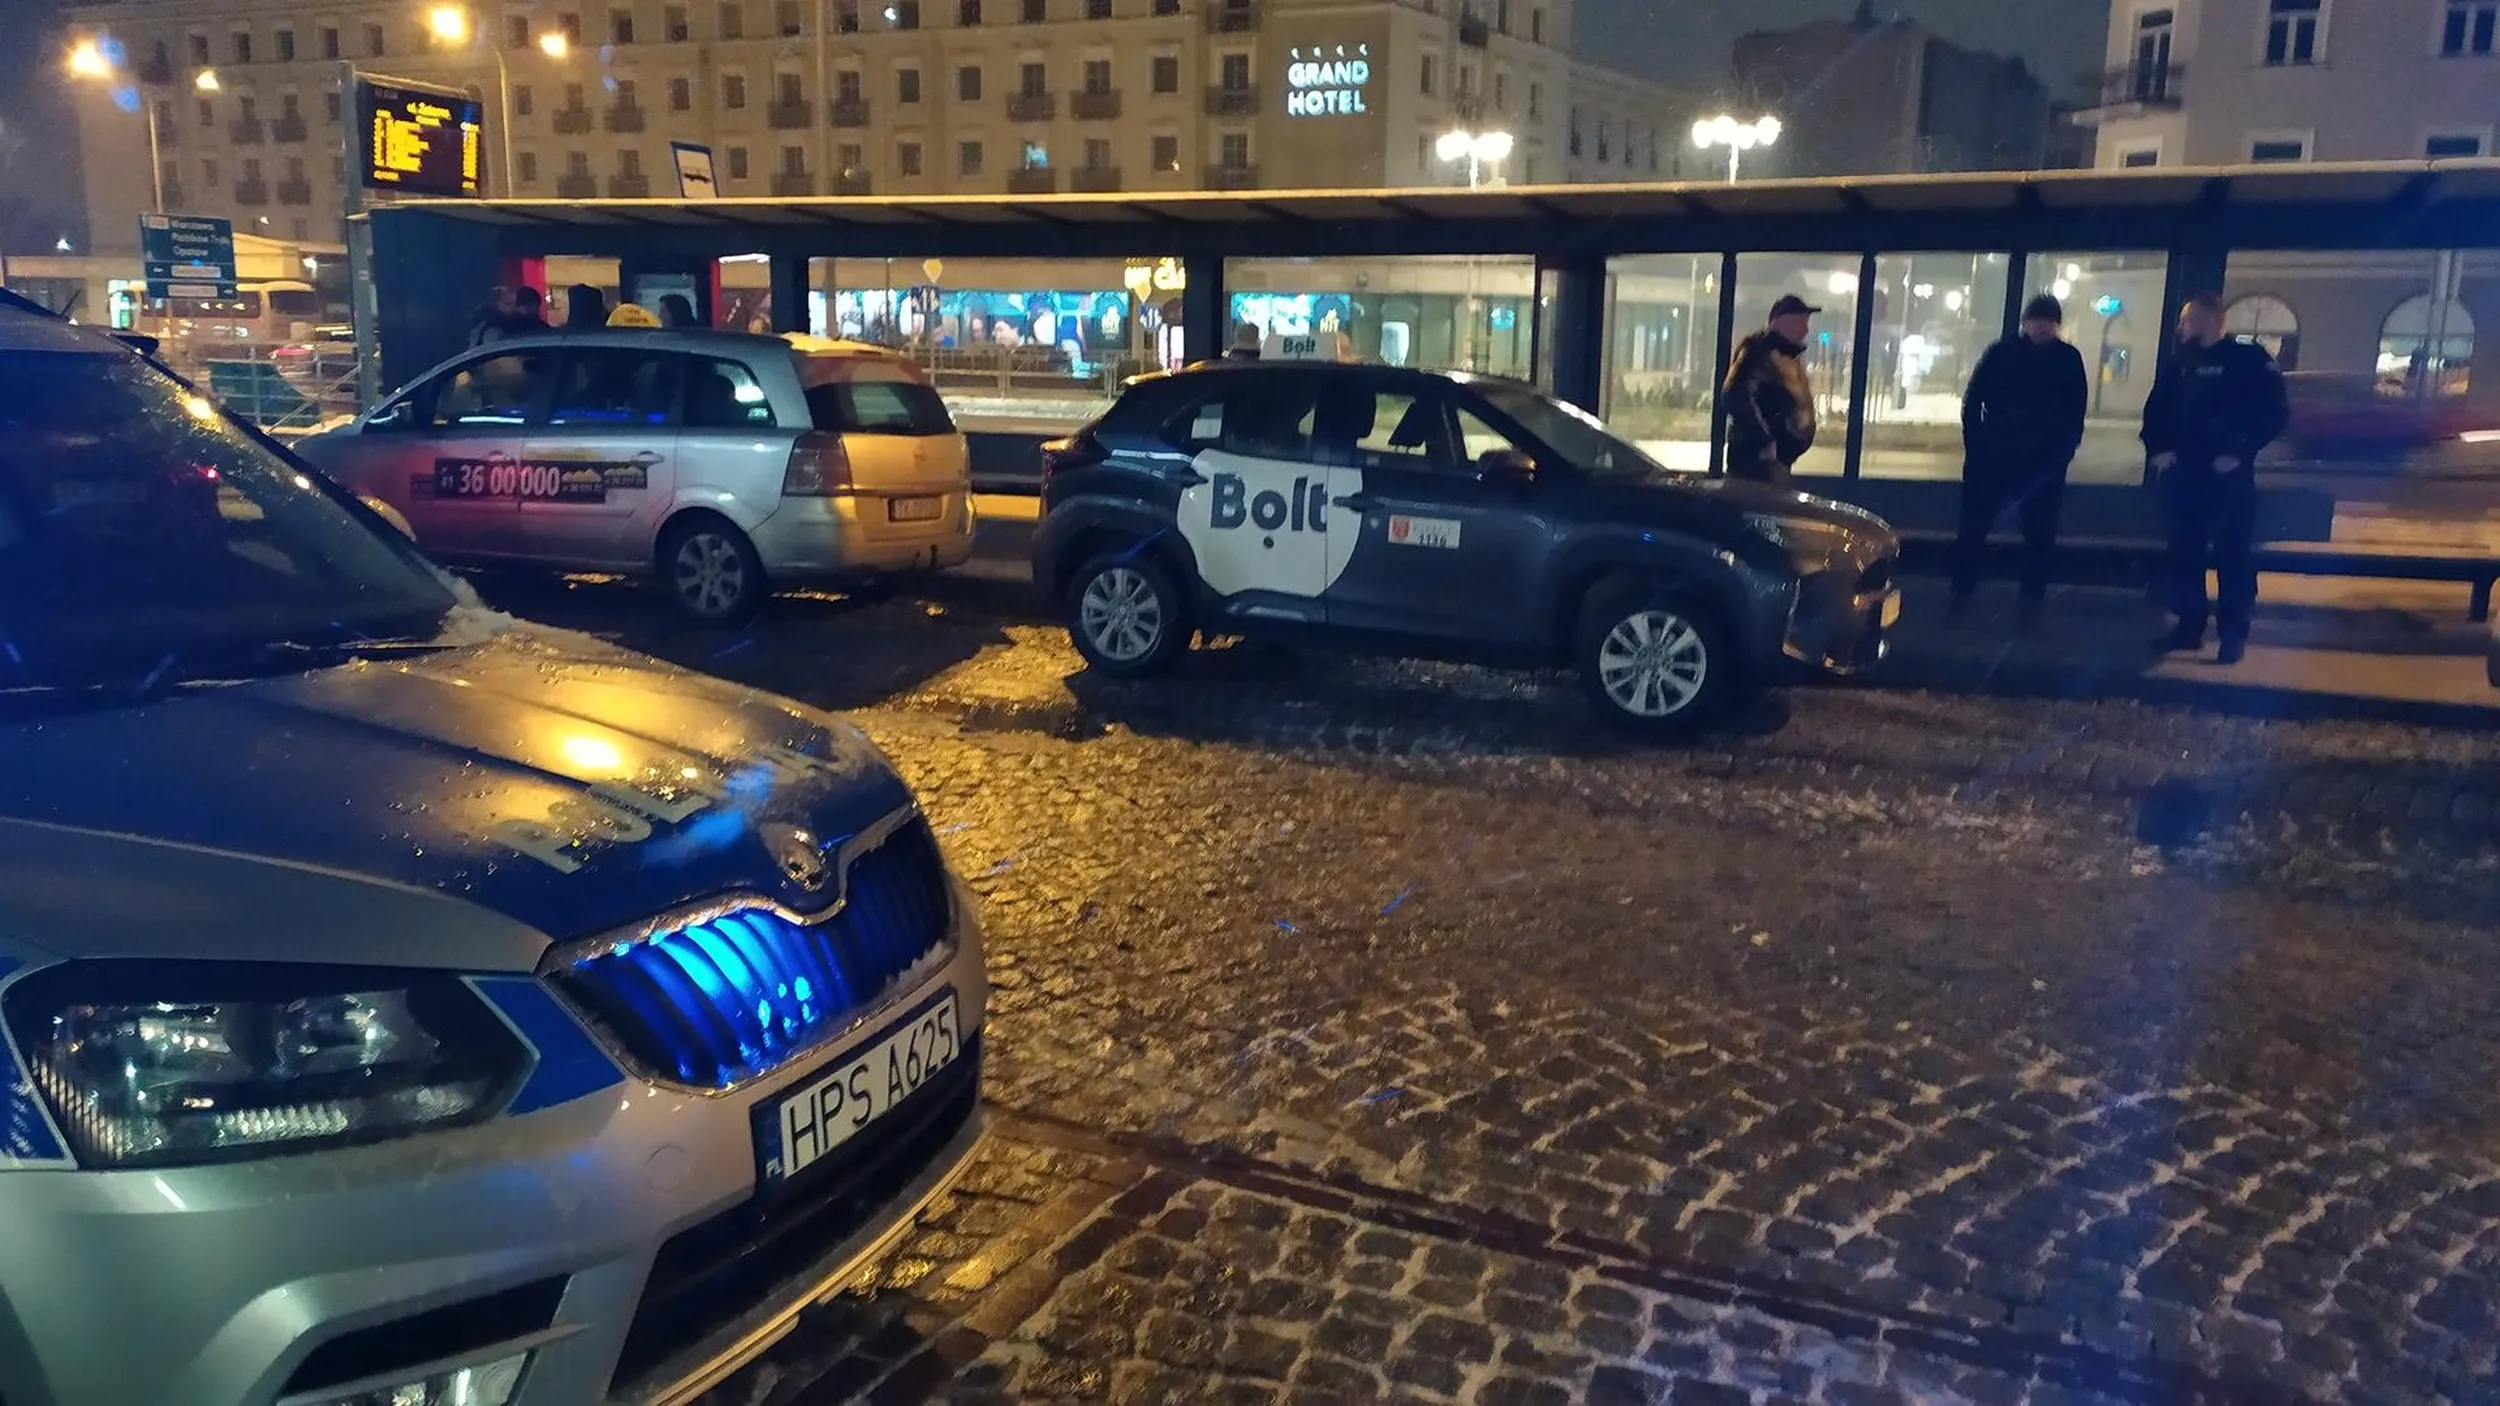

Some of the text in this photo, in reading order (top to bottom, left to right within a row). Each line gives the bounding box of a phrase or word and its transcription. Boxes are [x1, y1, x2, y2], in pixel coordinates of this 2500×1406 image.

[1288, 60, 1369, 88] GRAND
[1288, 90, 1367, 116] HOTEL
[1282, 336, 1316, 354] Bolt
[459, 465, 485, 494] 36
[489, 466, 516, 496] 00
[519, 466, 560, 497] 000
[1210, 473, 1328, 534] Bolt
[789, 1005, 952, 1170] HPS A625
